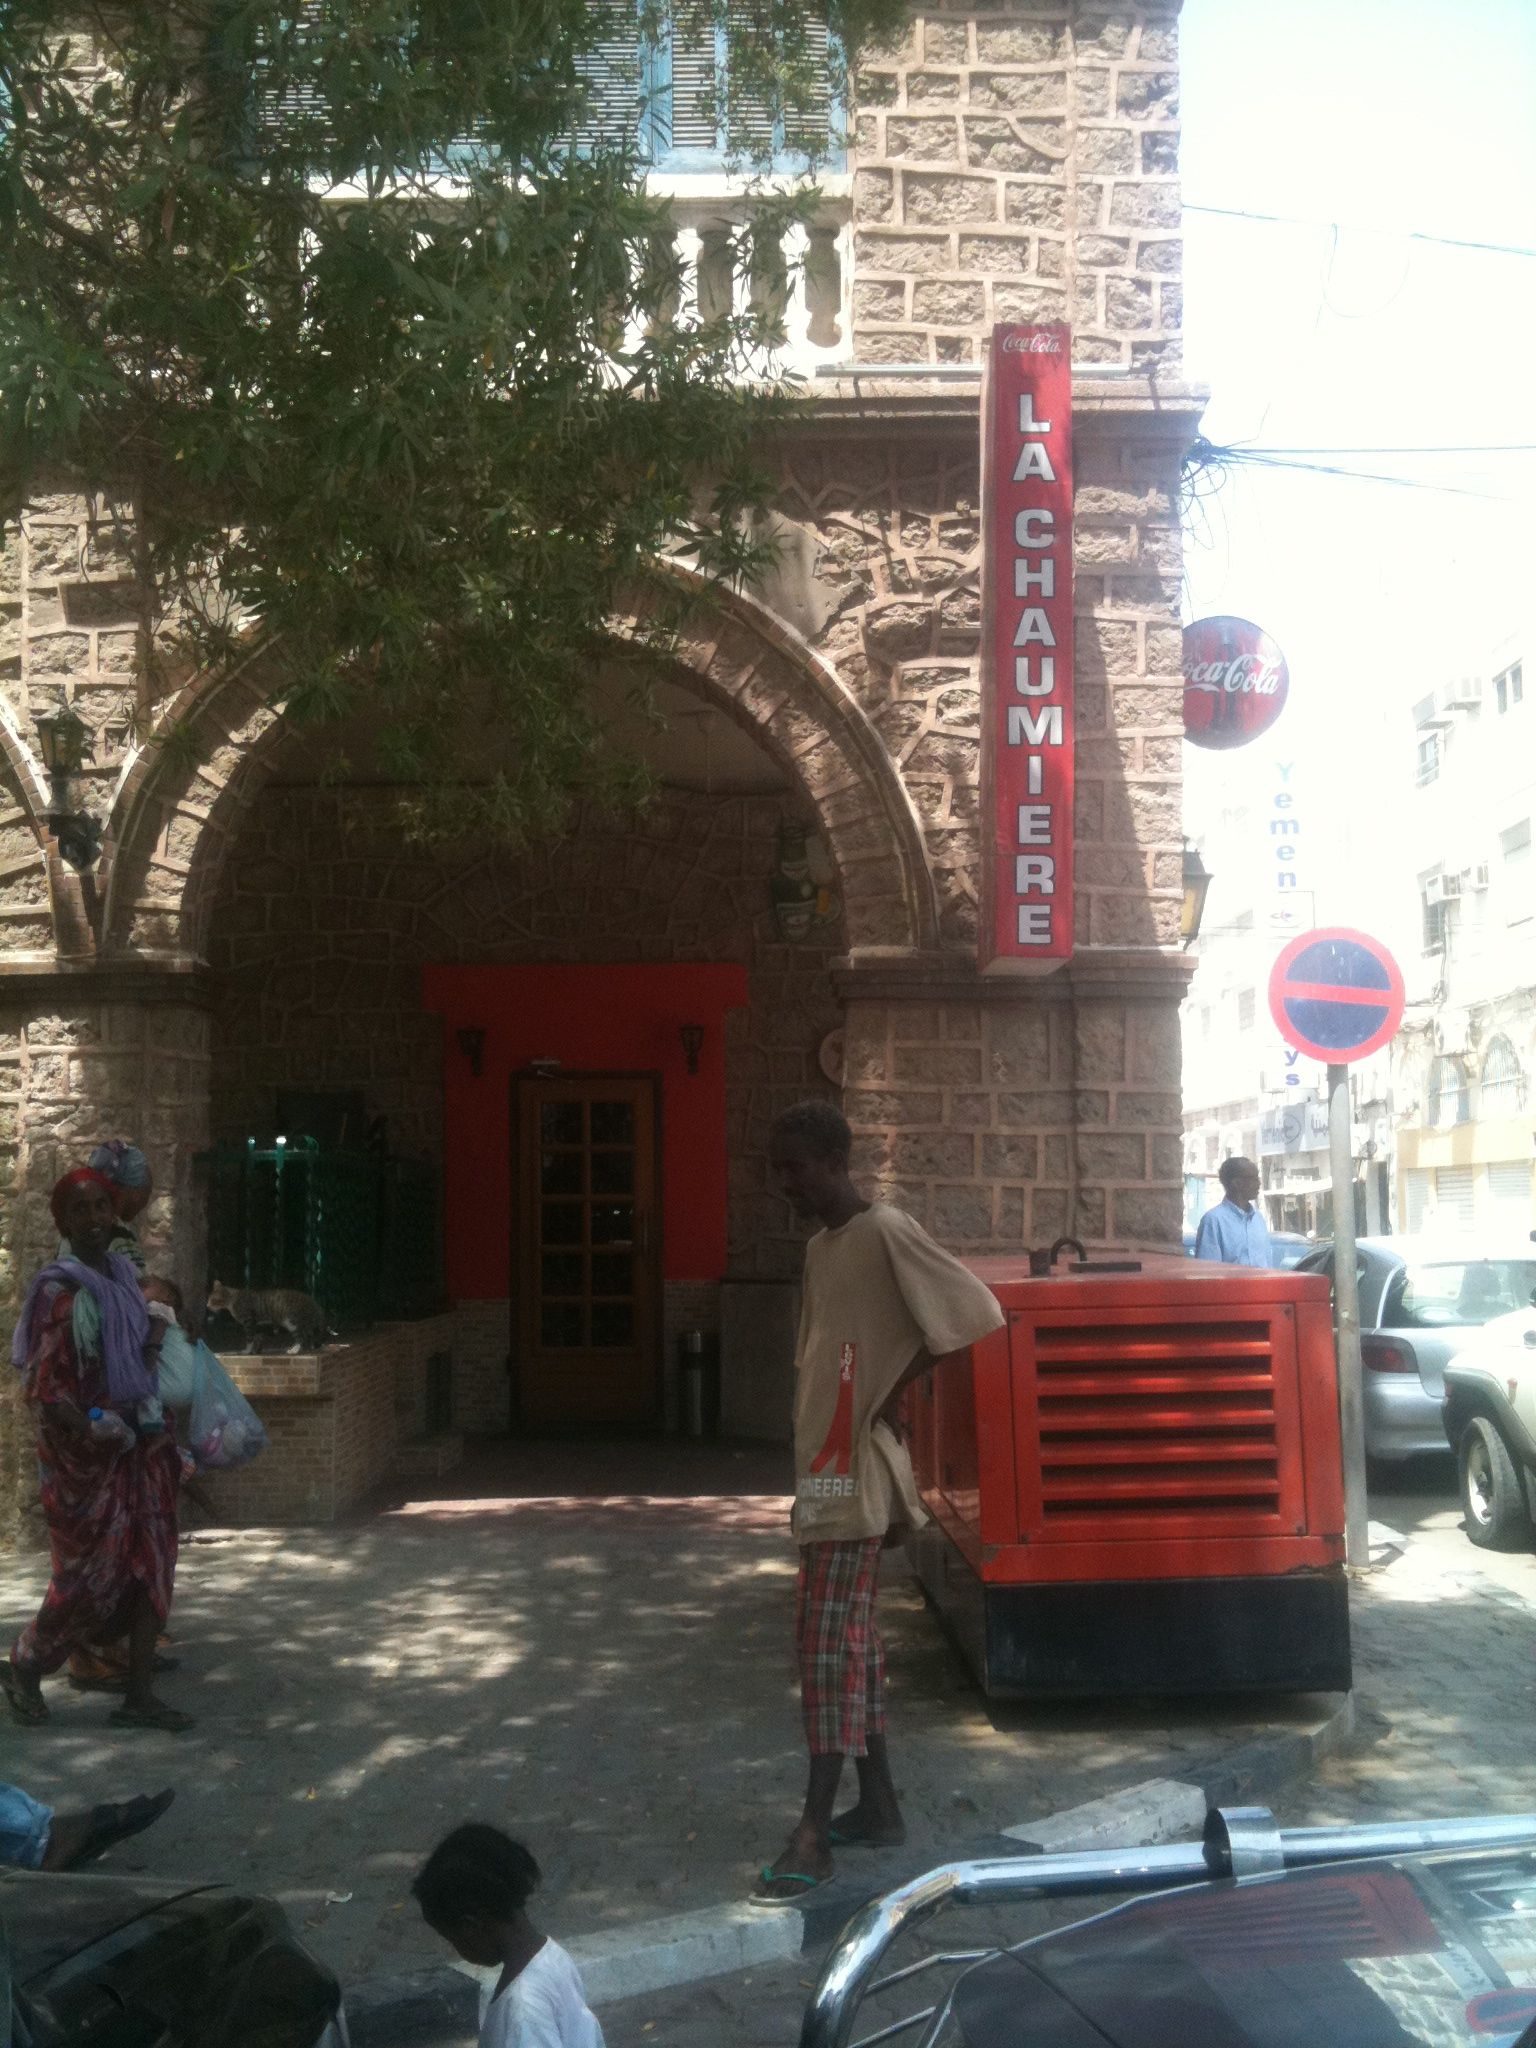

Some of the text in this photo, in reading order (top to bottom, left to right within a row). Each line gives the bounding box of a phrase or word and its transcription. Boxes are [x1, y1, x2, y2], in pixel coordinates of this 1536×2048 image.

[1002, 332, 1062, 353] Coca-Cola
[1008, 393, 1064, 945] LA CHAUMIERE
[1183, 653, 1282, 696] oca-Cola
[1269, 760, 1301, 888] Yemen
